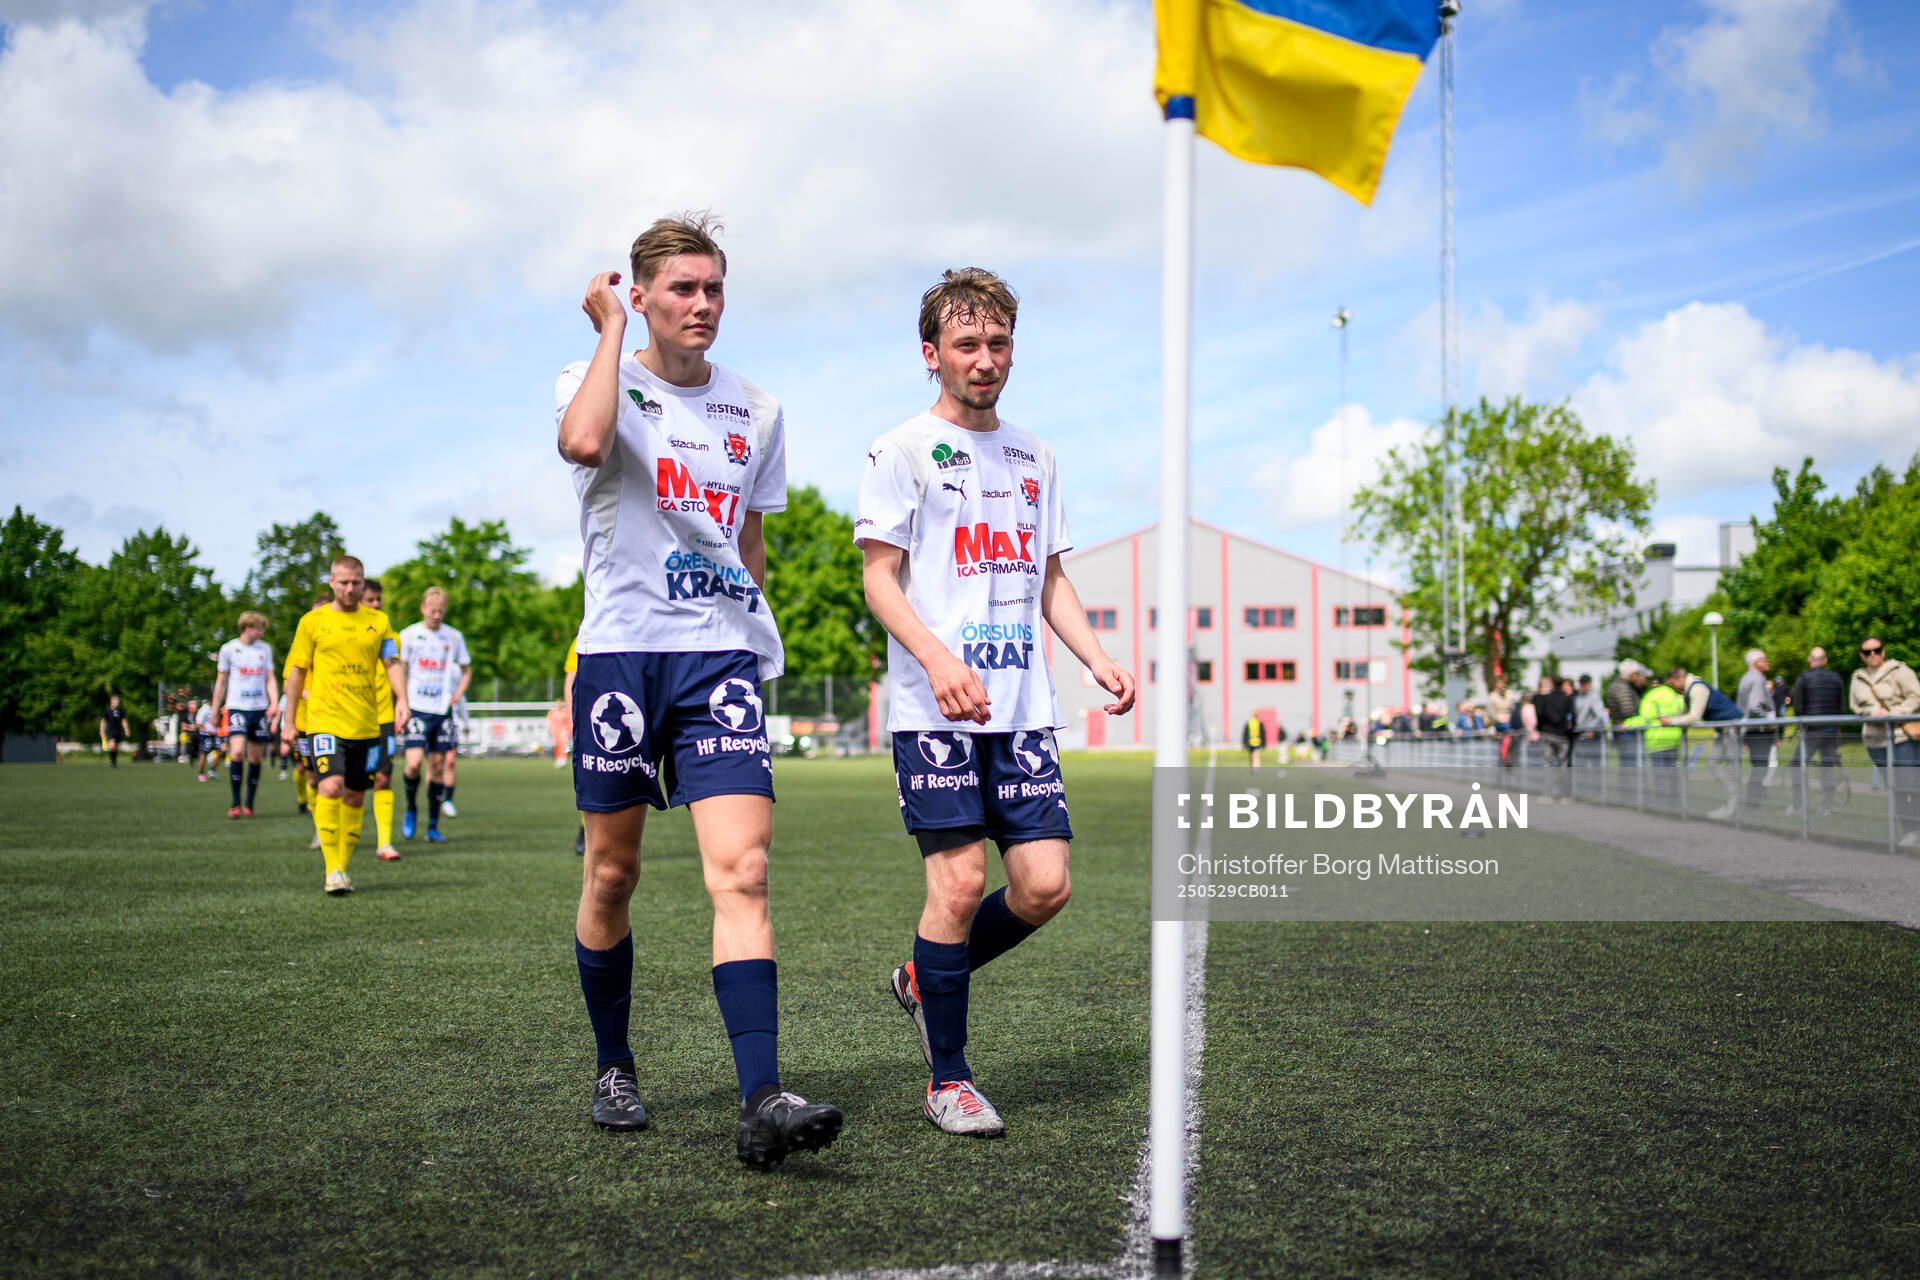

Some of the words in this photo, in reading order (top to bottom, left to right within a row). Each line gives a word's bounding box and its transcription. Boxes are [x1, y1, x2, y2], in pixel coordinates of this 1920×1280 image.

[717, 403, 750, 419] STENA
[707, 413, 751, 427] RECYCLING
[670, 439, 709, 452] stadium
[1011, 447, 1037, 465] STENA
[706, 480, 741, 495] HYLLINGE
[981, 488, 1012, 499] stadium
[657, 498, 678, 512] ICA
[954, 522, 1037, 566] MAX
[665, 550, 751, 585] ÖRESUND
[957, 566, 978, 578] ICA
[666, 571, 761, 613] KRAFT
[697, 737, 717, 756] HF
[582, 753, 596, 771] HF
[911, 774, 924, 790] HF
[998, 784, 1018, 800] HF
